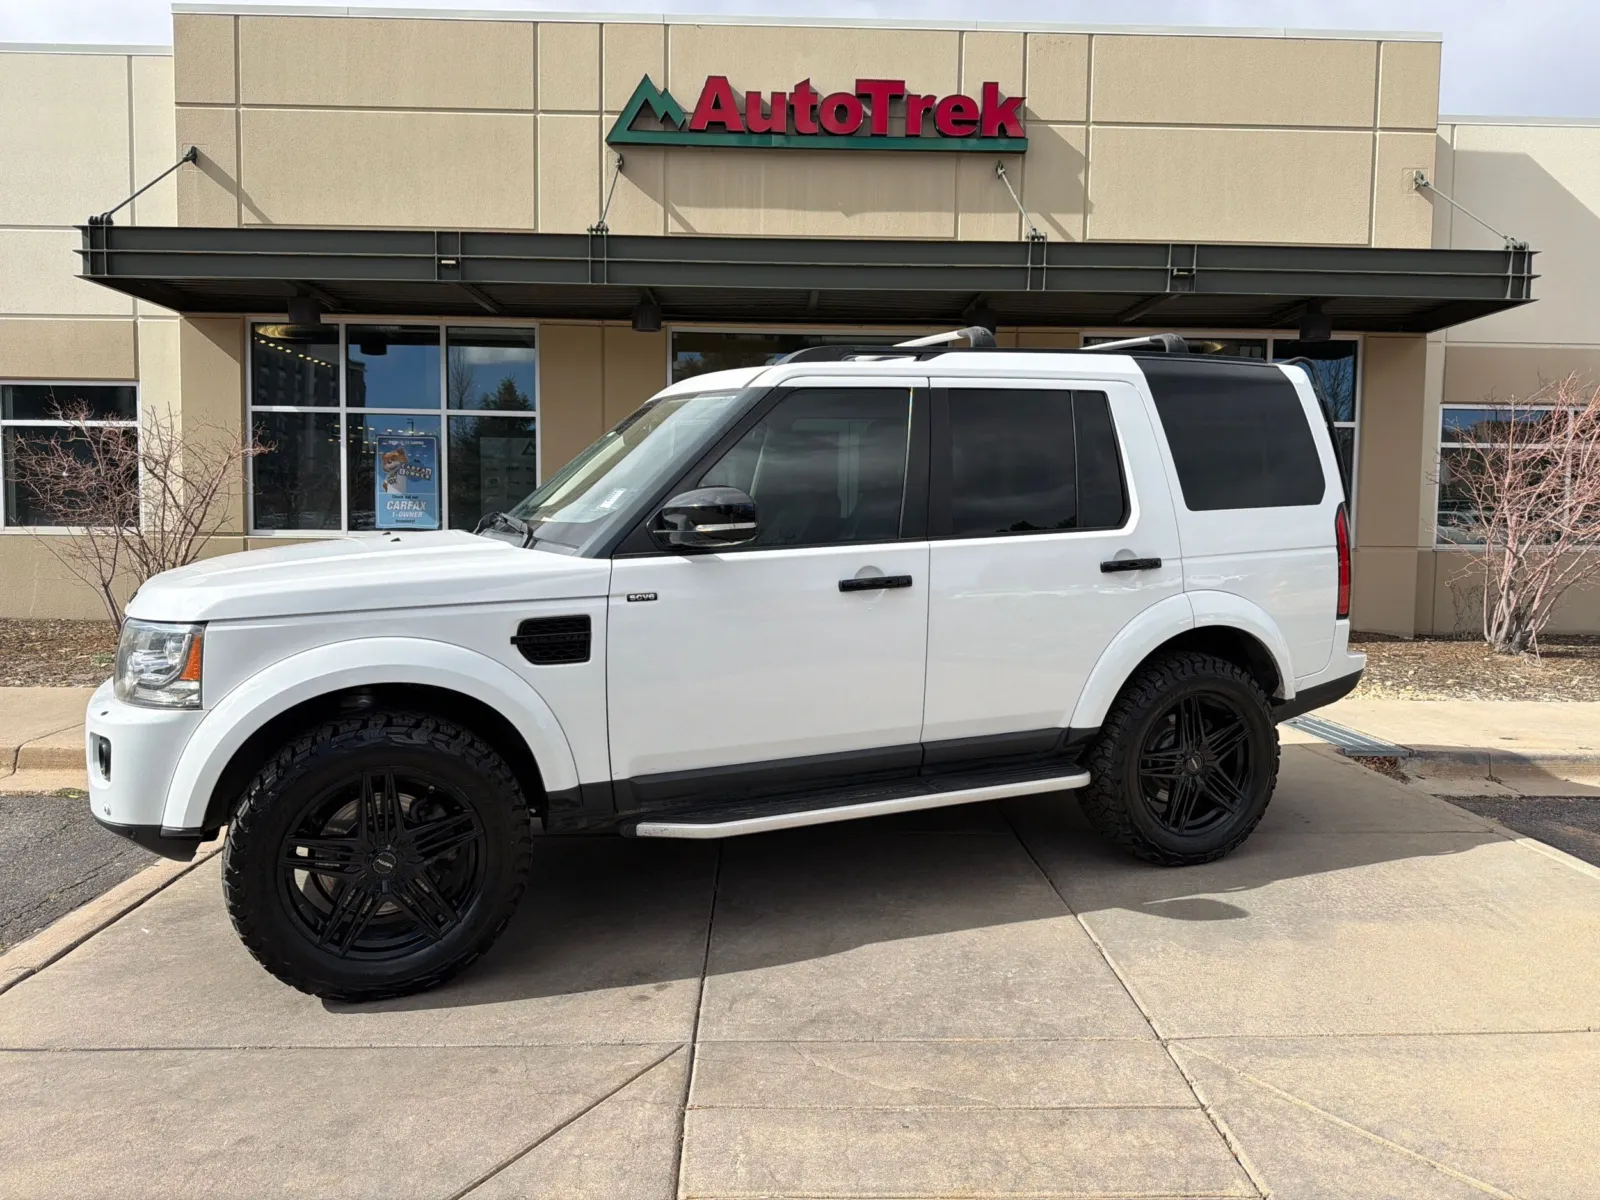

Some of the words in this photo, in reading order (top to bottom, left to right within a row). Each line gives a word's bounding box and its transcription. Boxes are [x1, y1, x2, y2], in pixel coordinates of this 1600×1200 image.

[689, 75, 1027, 138] AutoTrek
[386, 500, 427, 511] CARFAX
[629, 593, 656, 601] SCV6
